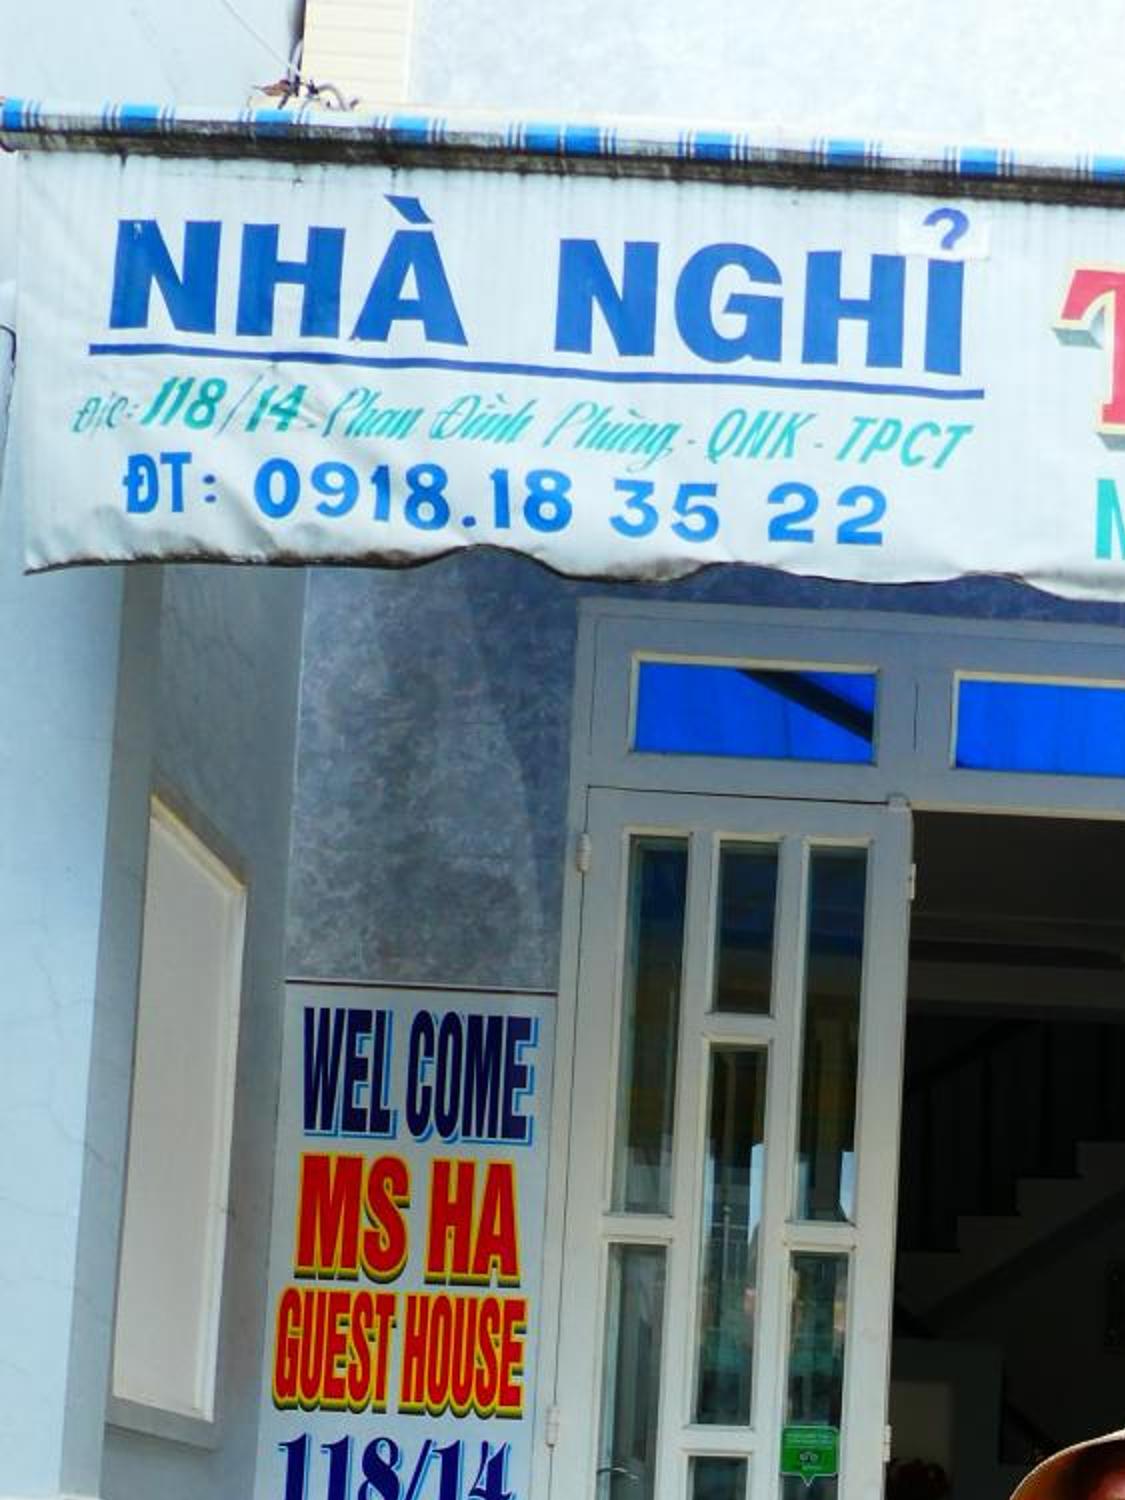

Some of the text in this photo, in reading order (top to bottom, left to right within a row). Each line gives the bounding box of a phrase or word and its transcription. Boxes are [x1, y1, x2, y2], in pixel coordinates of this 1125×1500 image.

[109, 194, 972, 376] NHÀ NGHỈ
[321, 387, 425, 440] Phan
[706, 407, 818, 463] QNK
[836, 415, 975, 470] TPCT
[122, 451, 217, 514] ĐT:
[608, 477, 720, 544] 35
[766, 481, 888, 546] 22
[294, 1151, 520, 1287] MS HA
[271, 1284, 525, 1419] GUEST HOUSE
